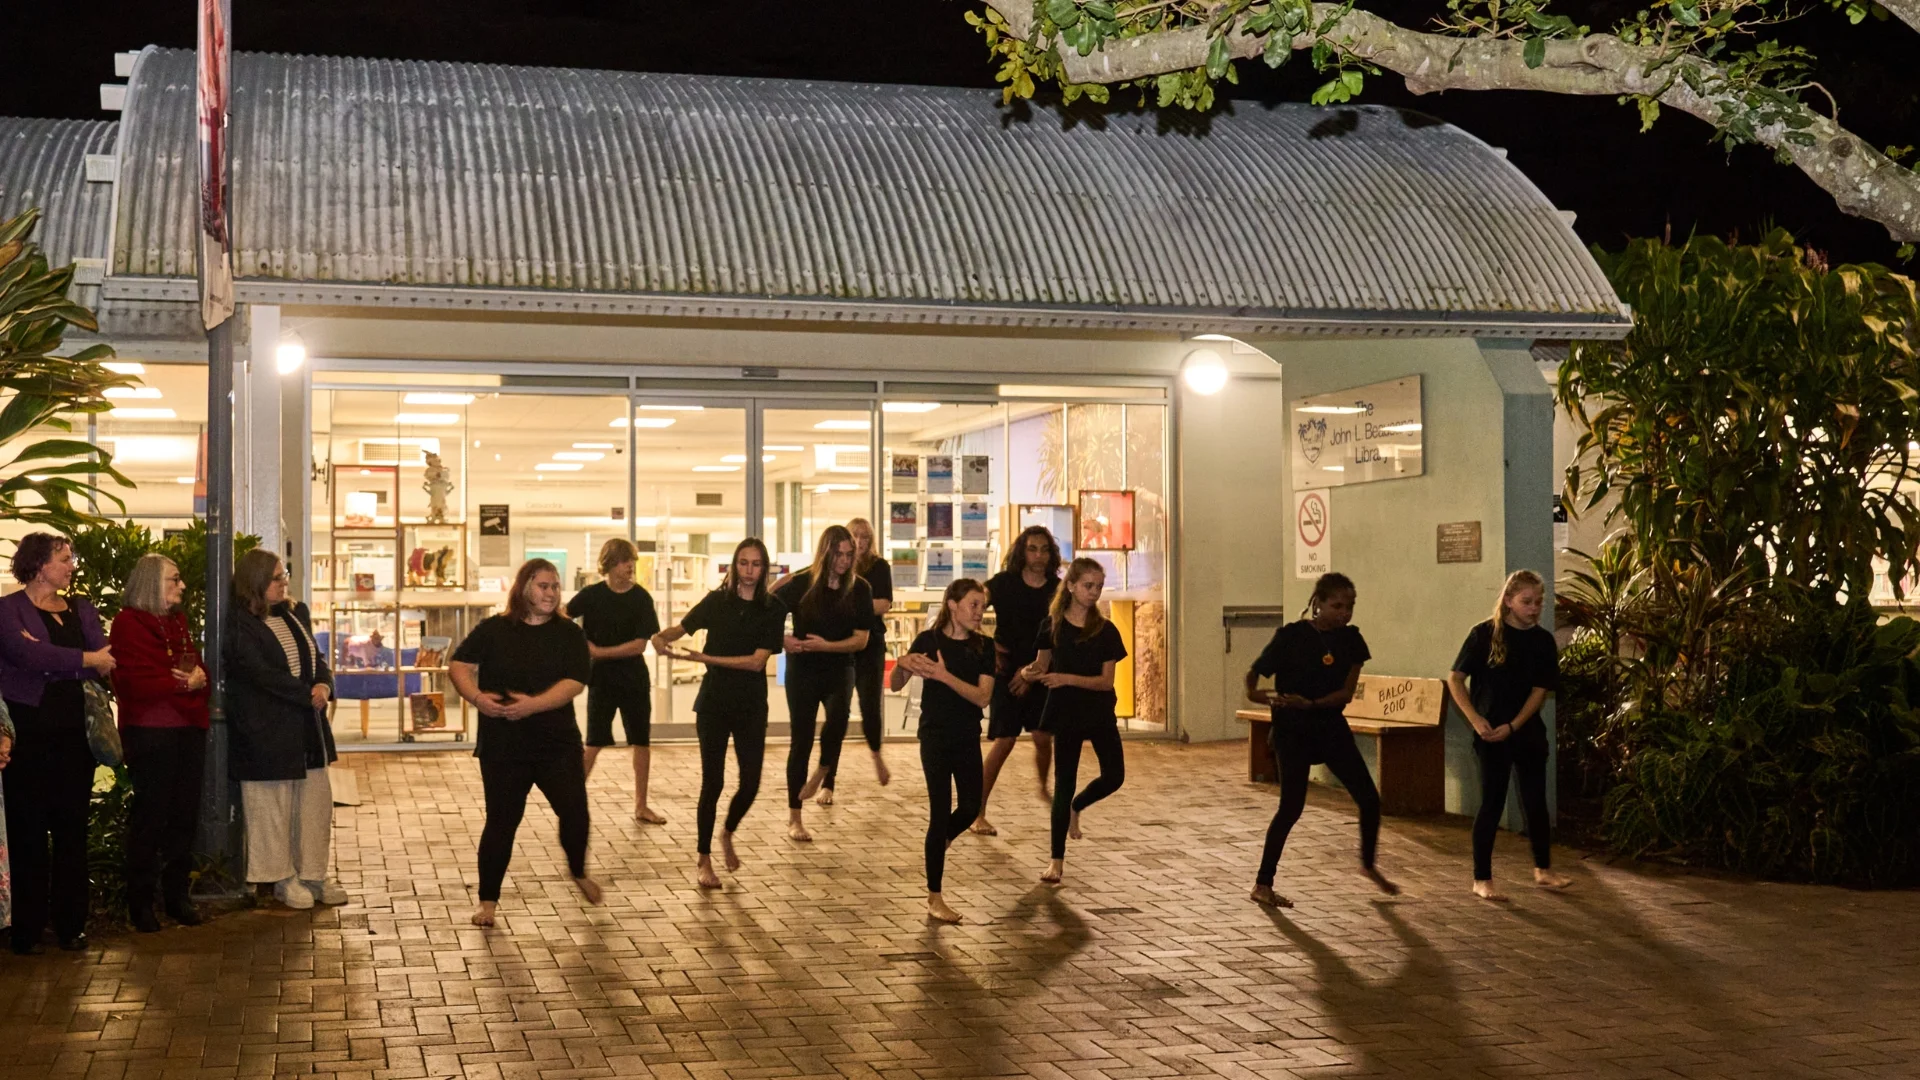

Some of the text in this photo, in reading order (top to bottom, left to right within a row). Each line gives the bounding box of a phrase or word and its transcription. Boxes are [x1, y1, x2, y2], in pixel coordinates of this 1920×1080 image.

[1355, 400, 1374, 418] The
[1330, 427, 1351, 446] John
[1355, 424, 1364, 441] L.
[1355, 446, 1388, 464] Libra
[1309, 553, 1317, 561] NO
[1301, 564, 1326, 573] SMOKING
[1379, 681, 1413, 702] BALOO
[1384, 698, 1406, 715] 2010
